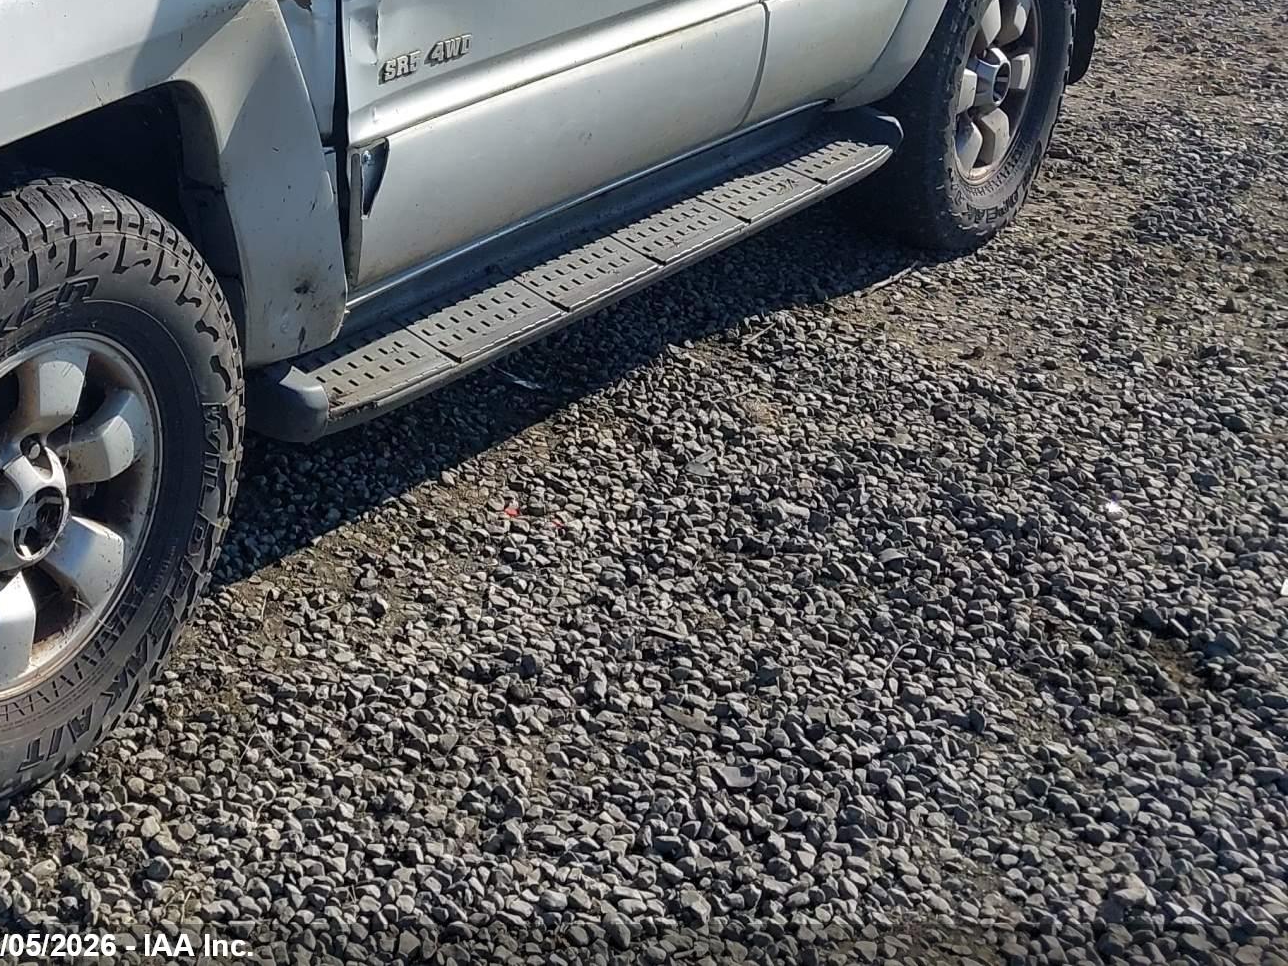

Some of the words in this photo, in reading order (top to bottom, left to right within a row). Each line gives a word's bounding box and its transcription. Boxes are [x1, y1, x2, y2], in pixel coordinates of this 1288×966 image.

[379, 49, 421, 85] SR5
[424, 33, 472, 66] 4WD
[16, 702, 94, 774] A/T
